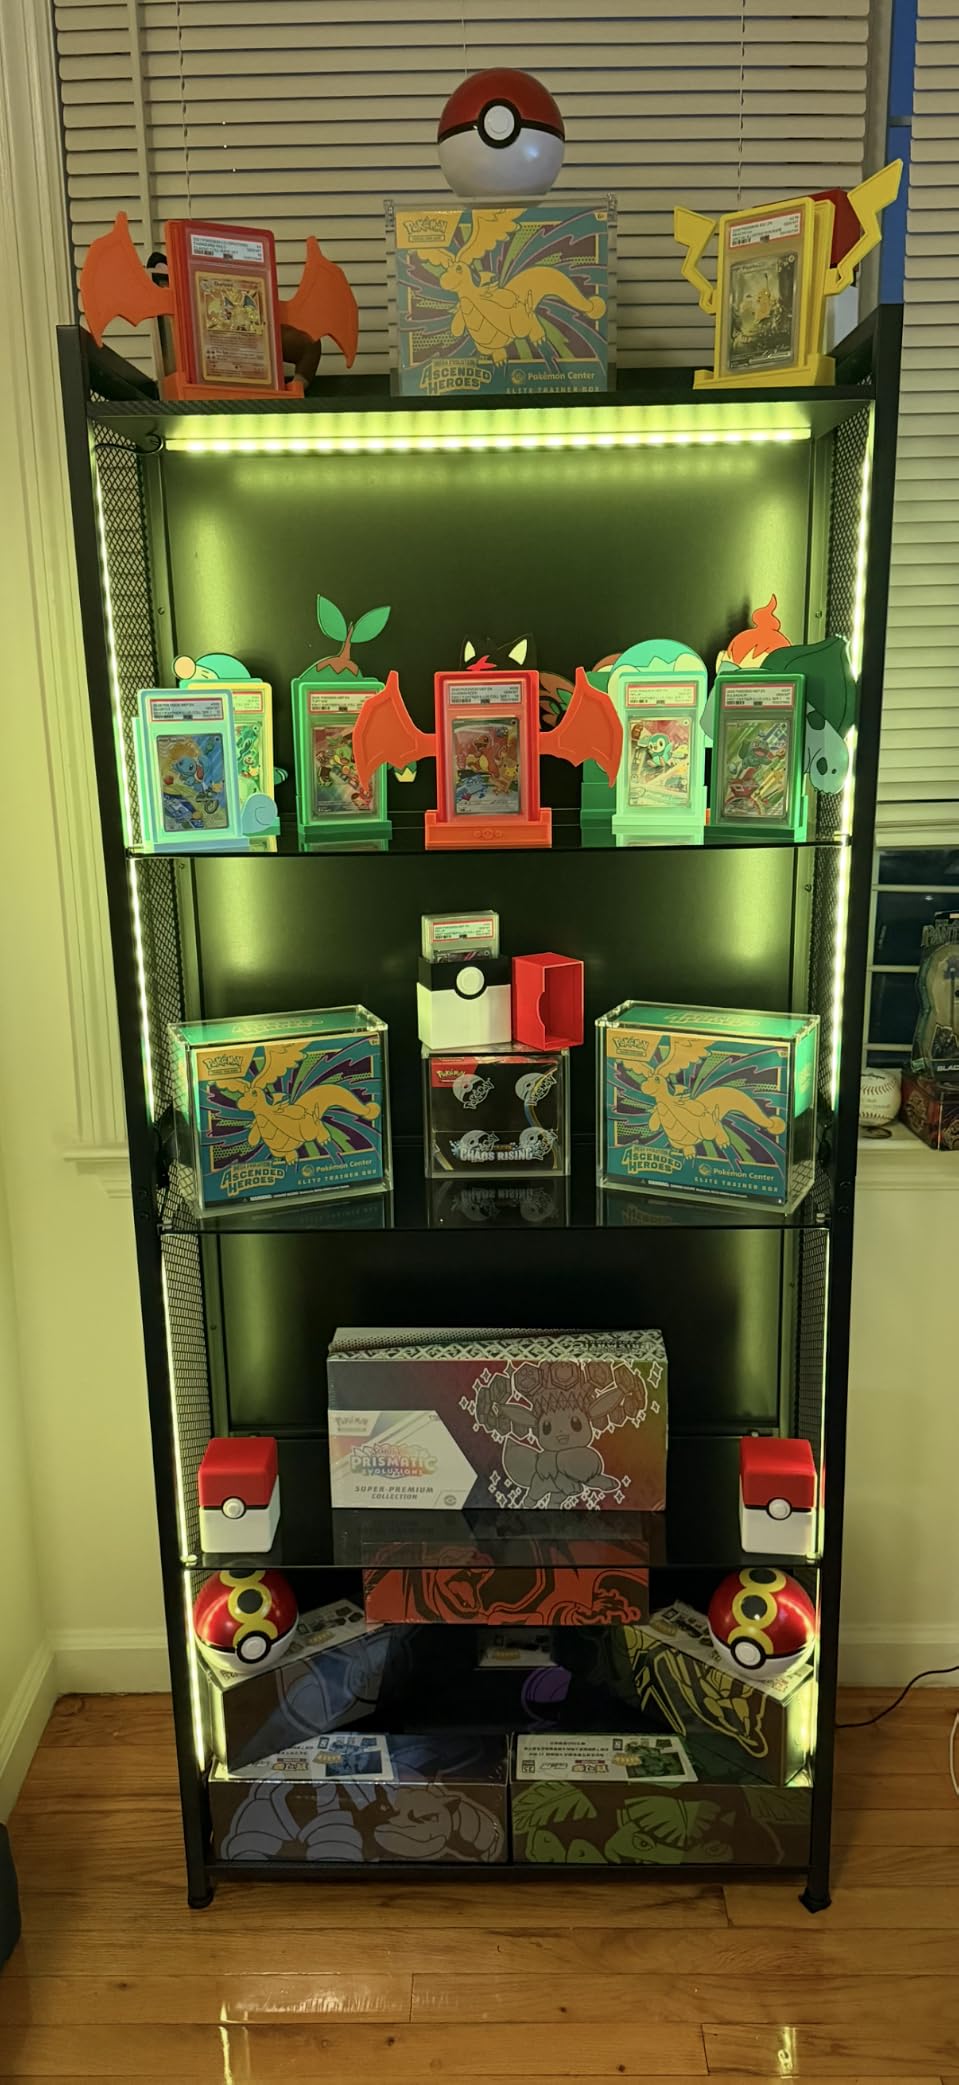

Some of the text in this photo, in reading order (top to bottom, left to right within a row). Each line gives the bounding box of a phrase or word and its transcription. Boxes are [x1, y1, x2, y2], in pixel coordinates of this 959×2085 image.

[421, 364, 491, 385] ASCENDED
[567, 371, 595, 380] Center
[427, 377, 480, 395] HEROES
[460, 1148, 494, 1161] CHAOS
[497, 1147, 533, 1160] RISING
[622, 1148, 682, 1169] ASCENDED
[350, 1159, 372, 1168] Center
[628, 1160, 672, 1173] HEROES
[221, 1168, 285, 1187] ASCENDED
[748, 1172, 775, 1181] Center
[228, 1176, 275, 1194] HEROES
[722, 1180, 758, 1190] TRAINER
[351, 1455, 438, 1473] PRISMATIC
[362, 1467, 424, 1476] EVOLUTIONS
[354, 1485, 434, 1493] SUPER-PREMIUM
